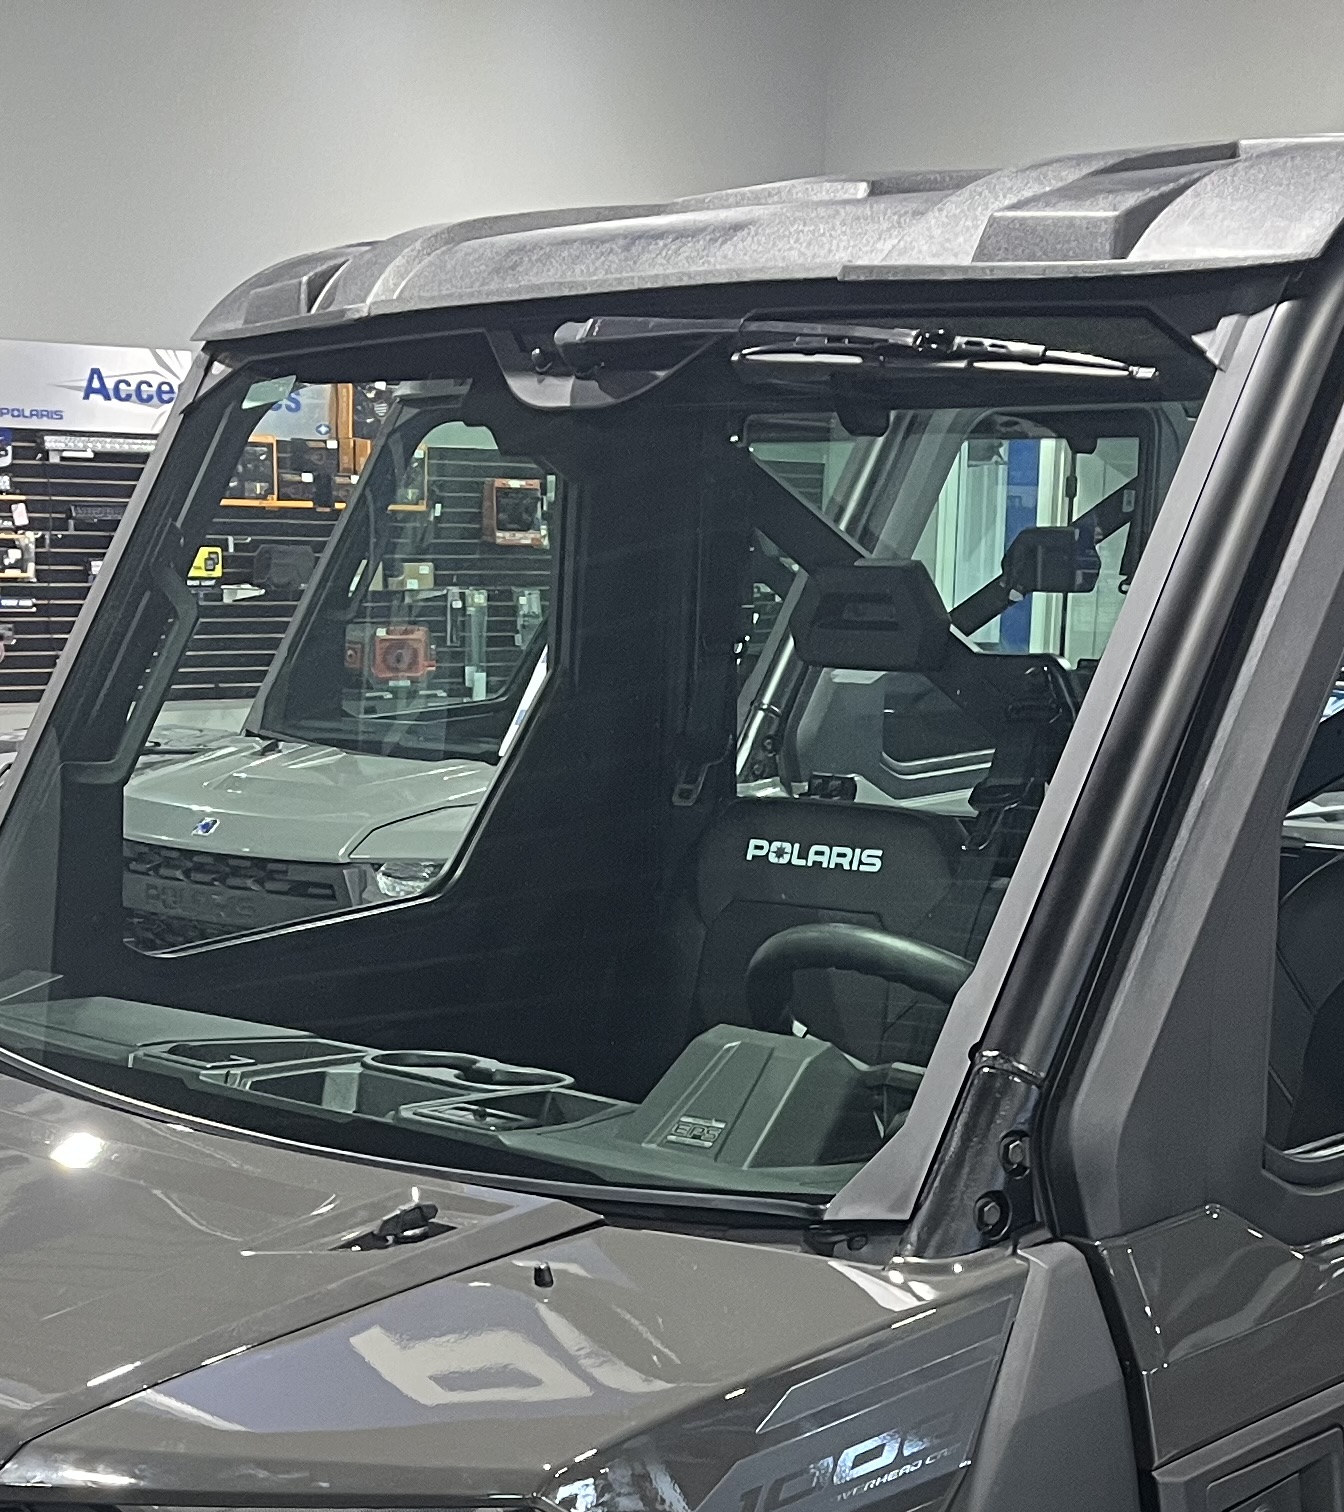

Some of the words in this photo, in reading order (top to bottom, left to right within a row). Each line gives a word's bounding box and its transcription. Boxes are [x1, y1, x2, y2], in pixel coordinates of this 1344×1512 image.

[0, 407, 64, 421] POLARIS
[746, 838, 884, 873] POLARIS
[674, 1123, 722, 1141] EPS
